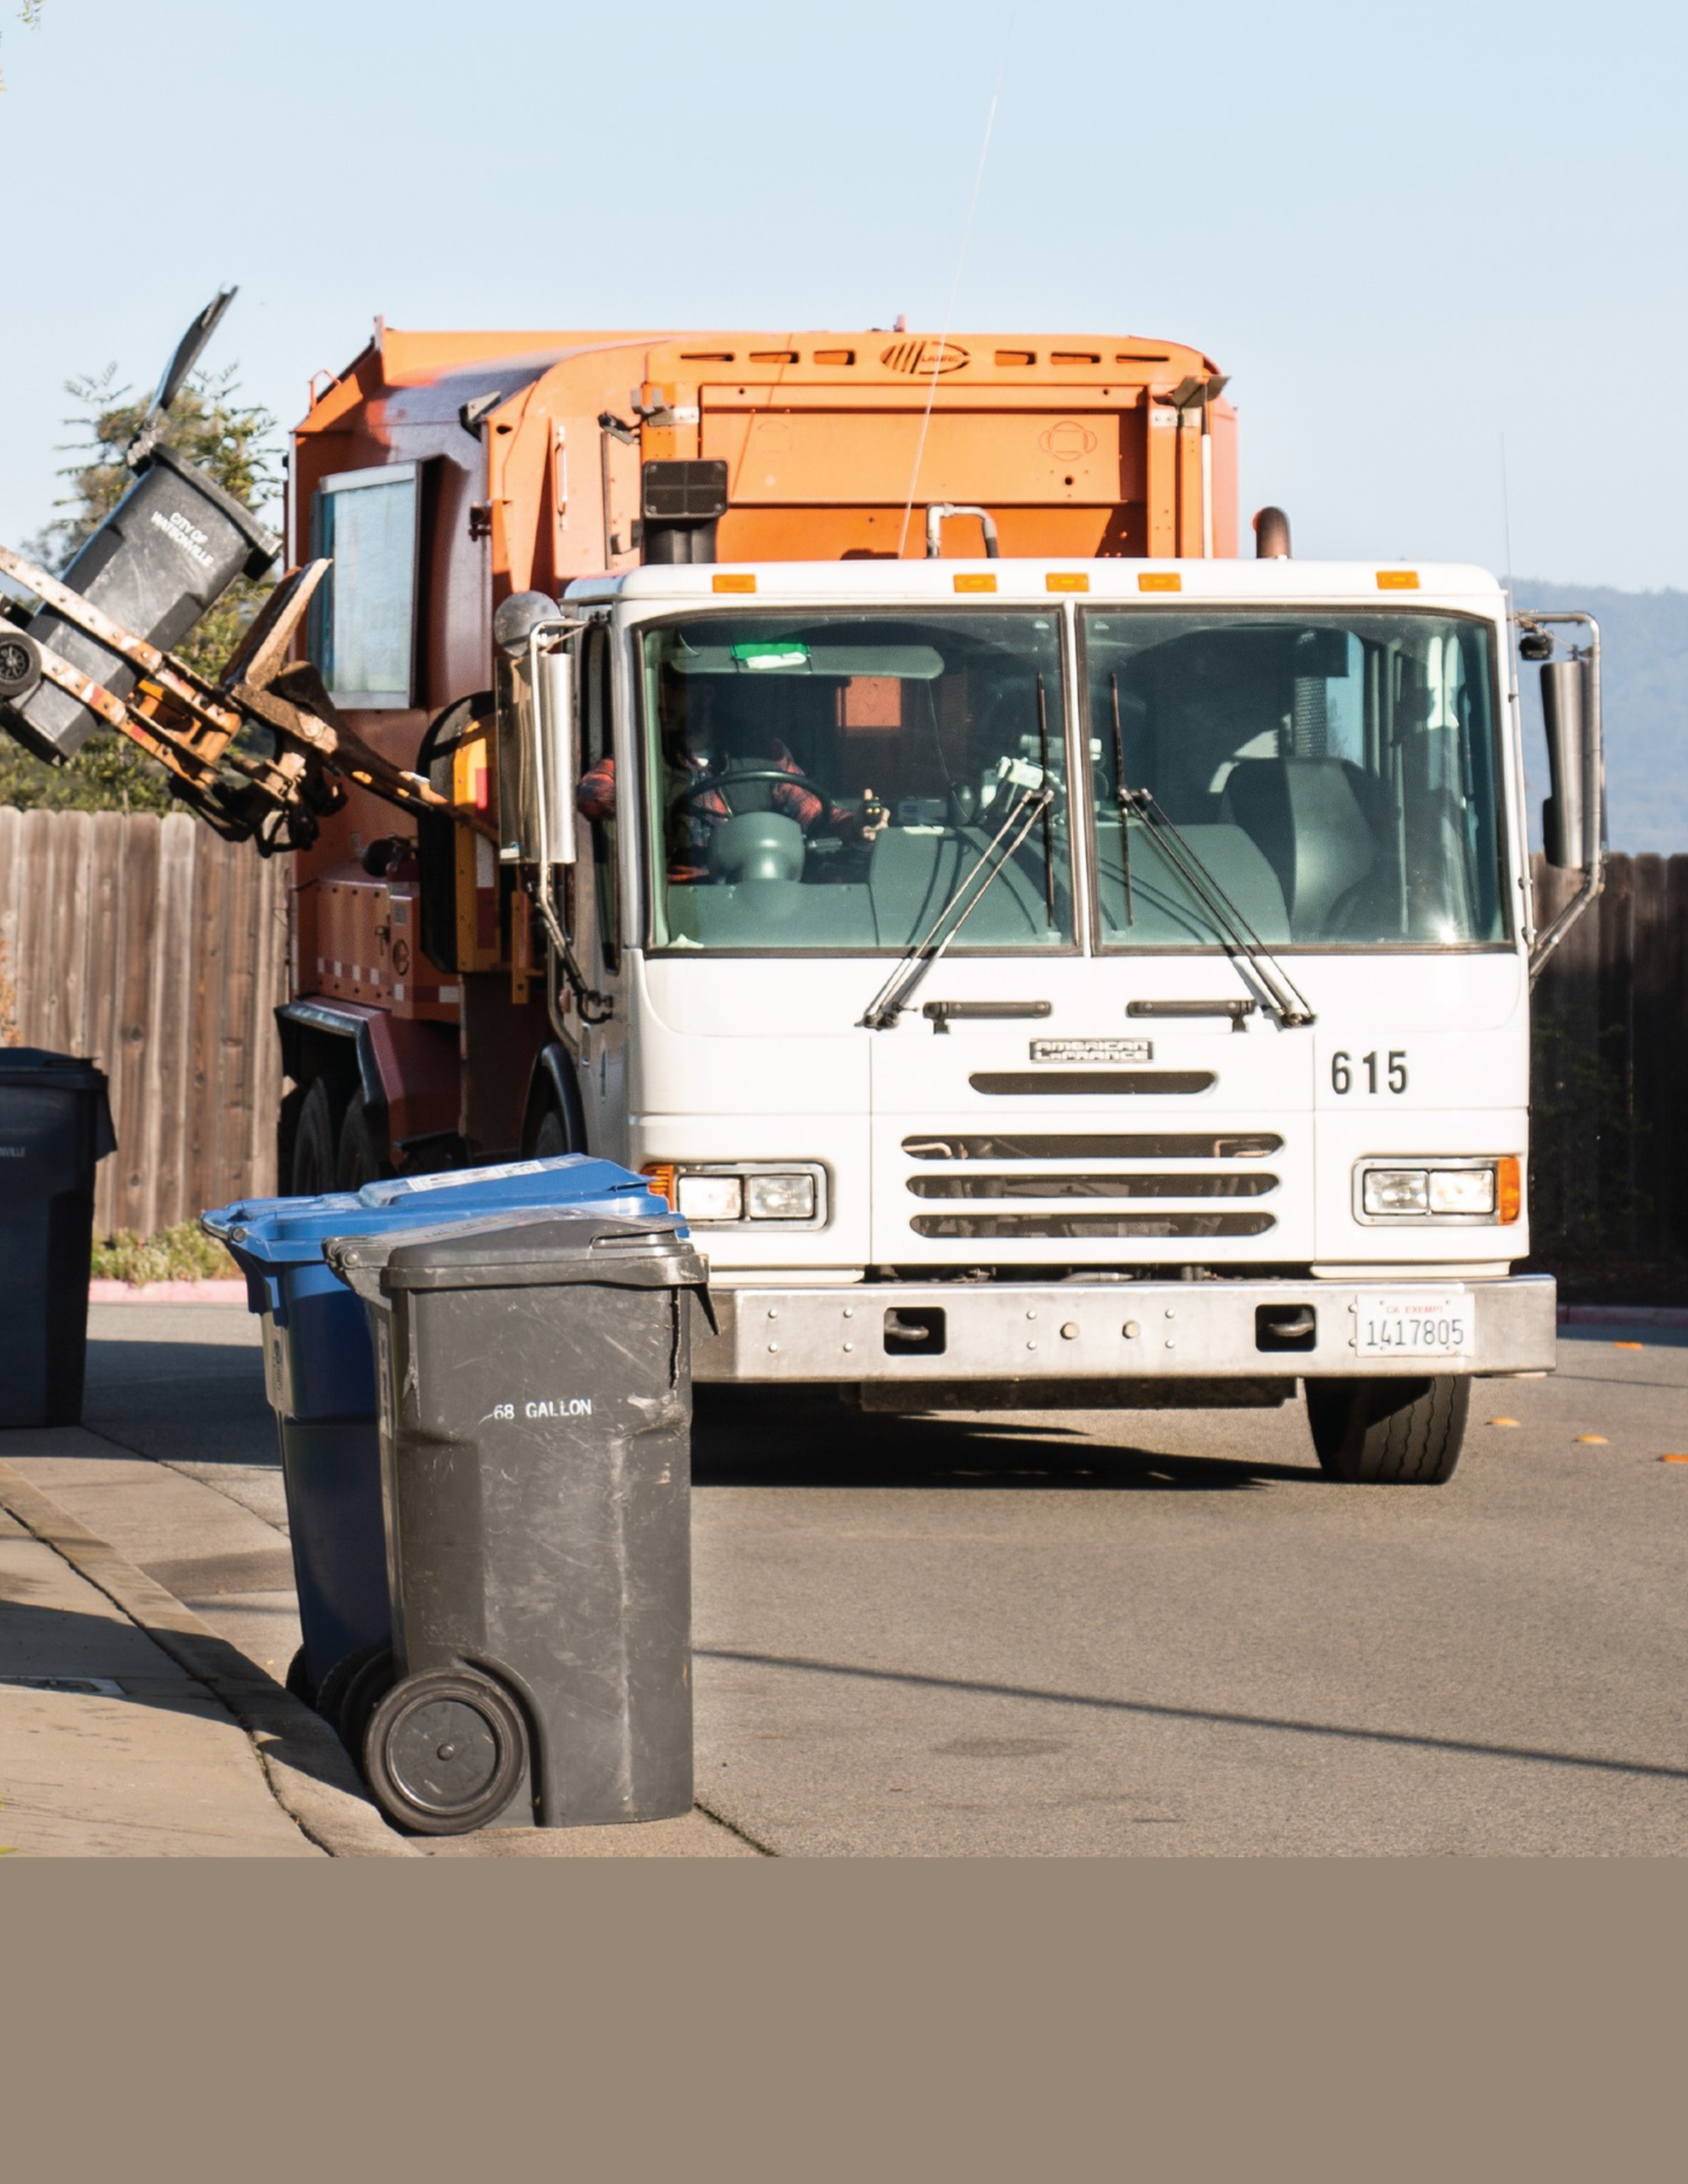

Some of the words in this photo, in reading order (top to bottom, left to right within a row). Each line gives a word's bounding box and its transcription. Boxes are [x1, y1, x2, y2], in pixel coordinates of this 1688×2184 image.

[150, 511, 214, 568] WATSONVILLE
[170, 512, 196, 535] CITY
[190, 529, 208, 545] OF
[1331, 1050, 1408, 1095] 615
[1386, 1305, 1400, 1314] CA
[1405, 1305, 1444, 1314] EXEMPT
[1366, 1319, 1464, 1346] 1417805
[493, 1403, 515, 1420] 68
[525, 1399, 592, 1419] GALLON
